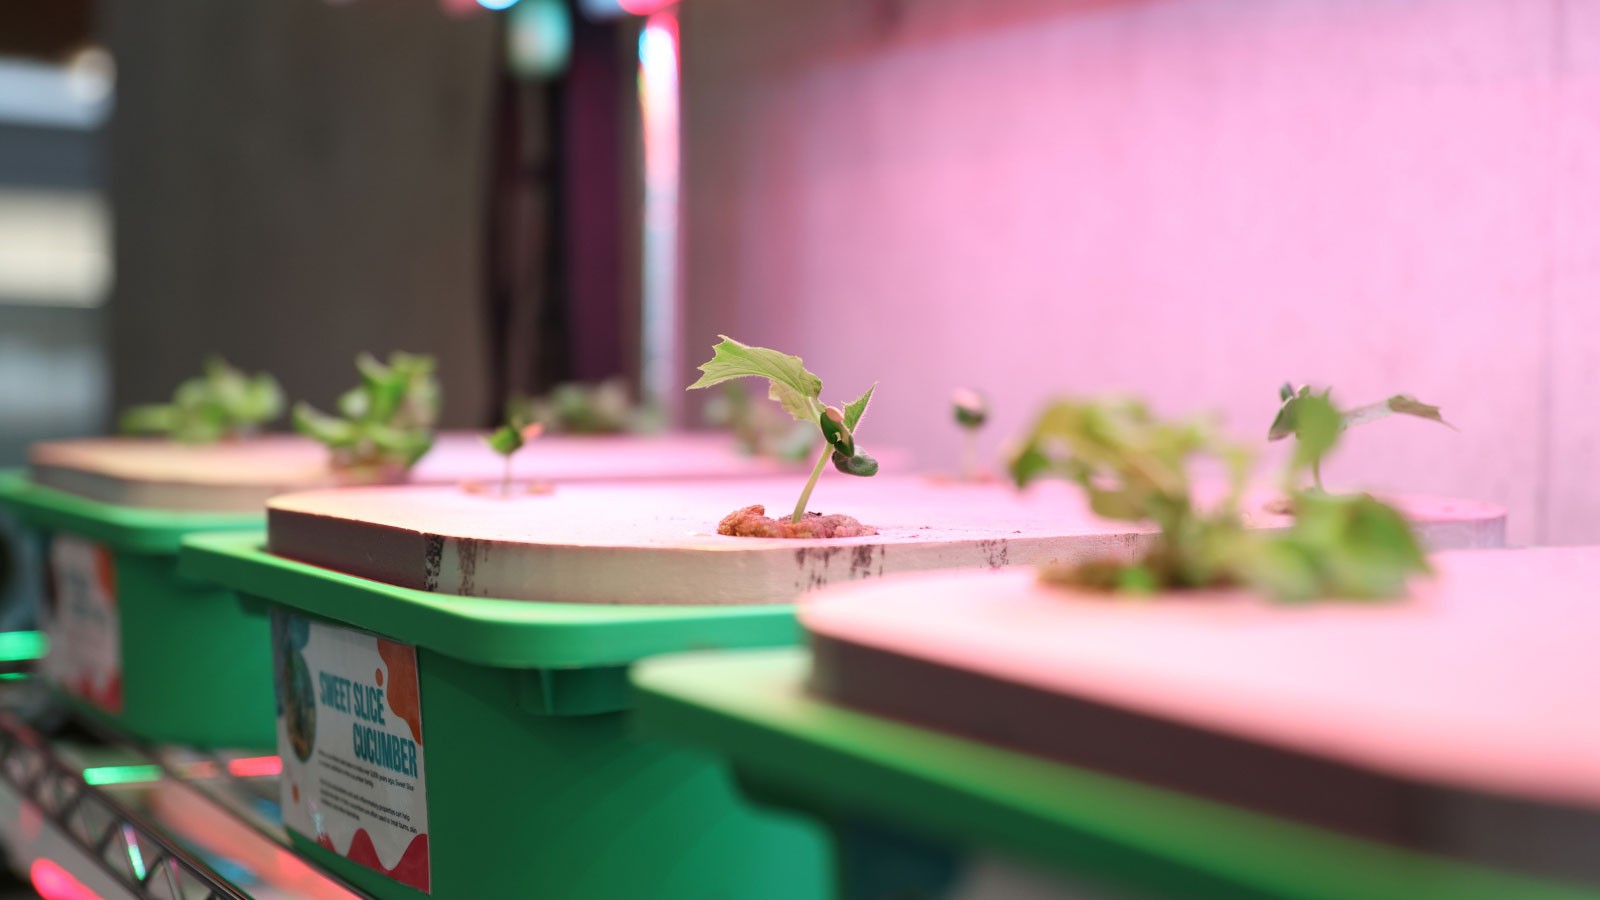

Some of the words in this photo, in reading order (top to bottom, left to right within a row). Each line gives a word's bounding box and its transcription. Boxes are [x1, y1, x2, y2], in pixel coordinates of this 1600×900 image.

[319, 671, 351, 714] SWEET
[353, 681, 385, 726] SLICE
[353, 723, 418, 779] CUCUMBER
